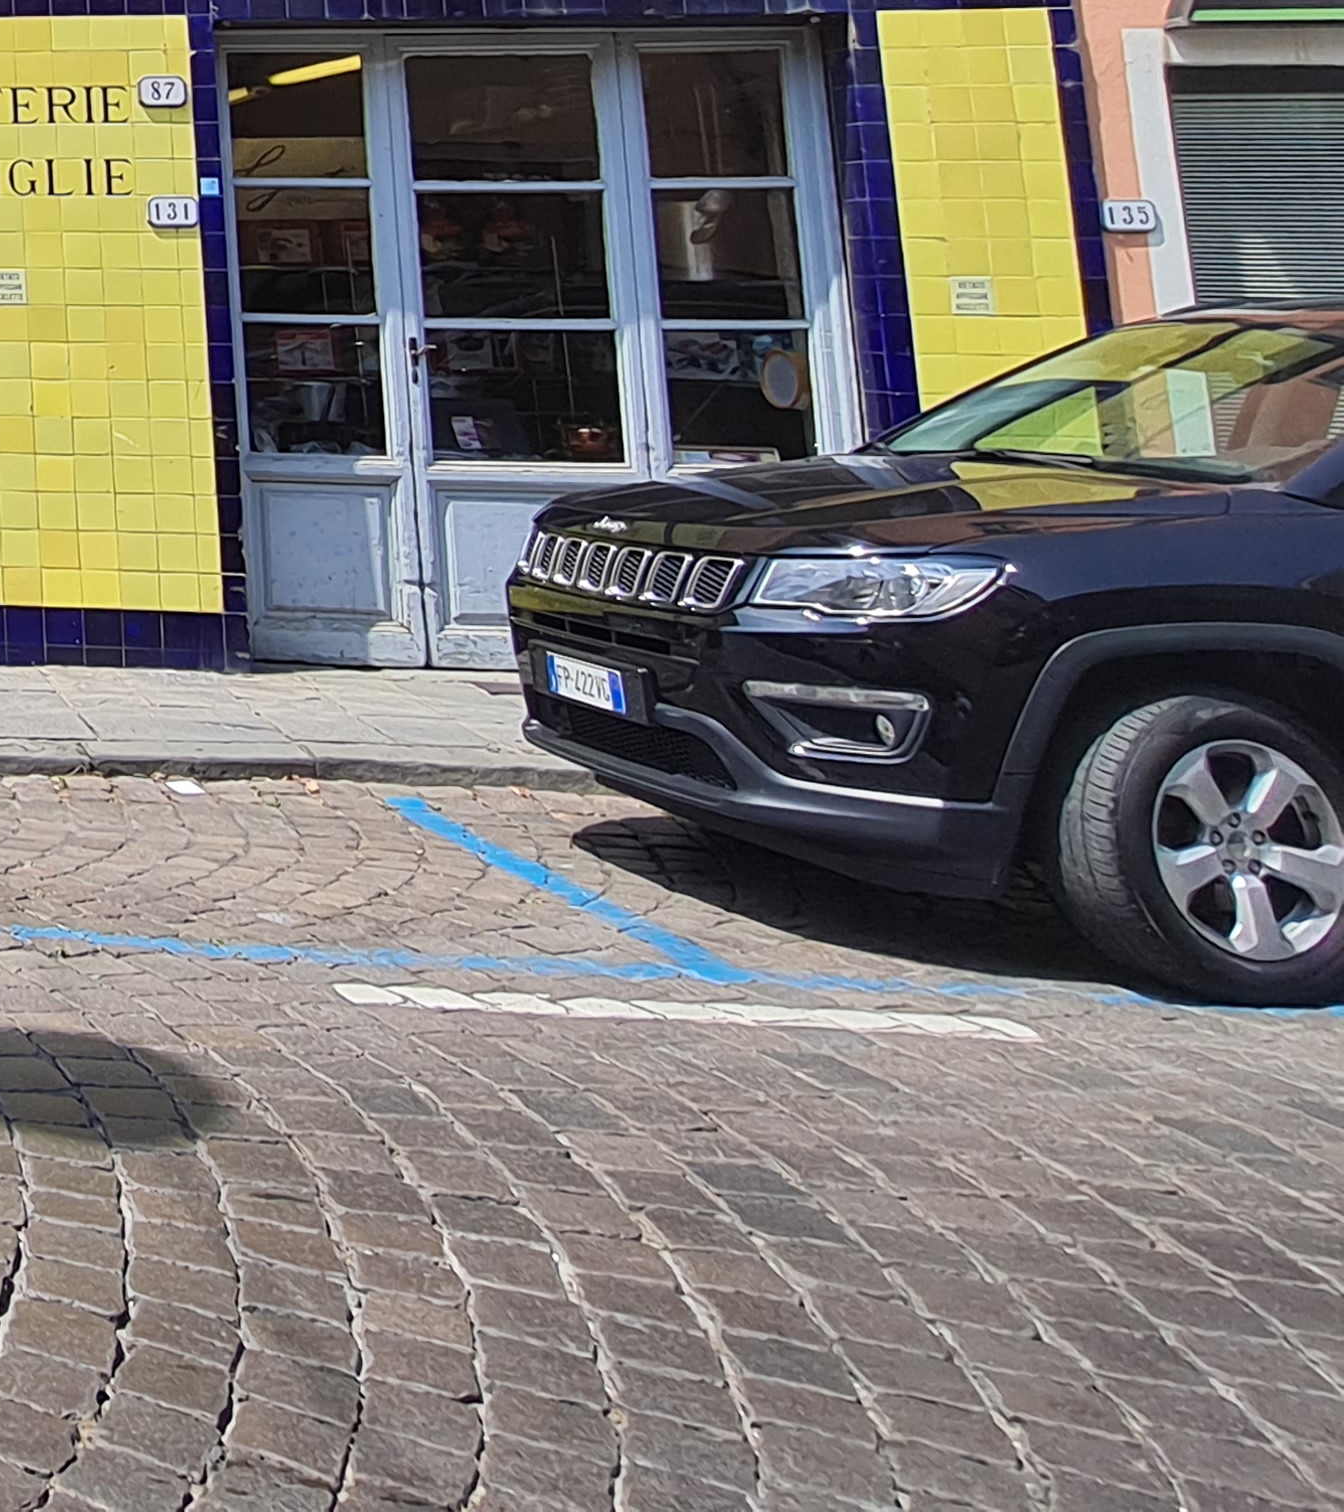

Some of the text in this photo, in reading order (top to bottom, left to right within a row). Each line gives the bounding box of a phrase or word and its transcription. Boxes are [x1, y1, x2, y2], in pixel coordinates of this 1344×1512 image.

[150, 80, 175, 101] 87
[154, 202, 189, 221] 131
[1108, 205, 1150, 226] 135
